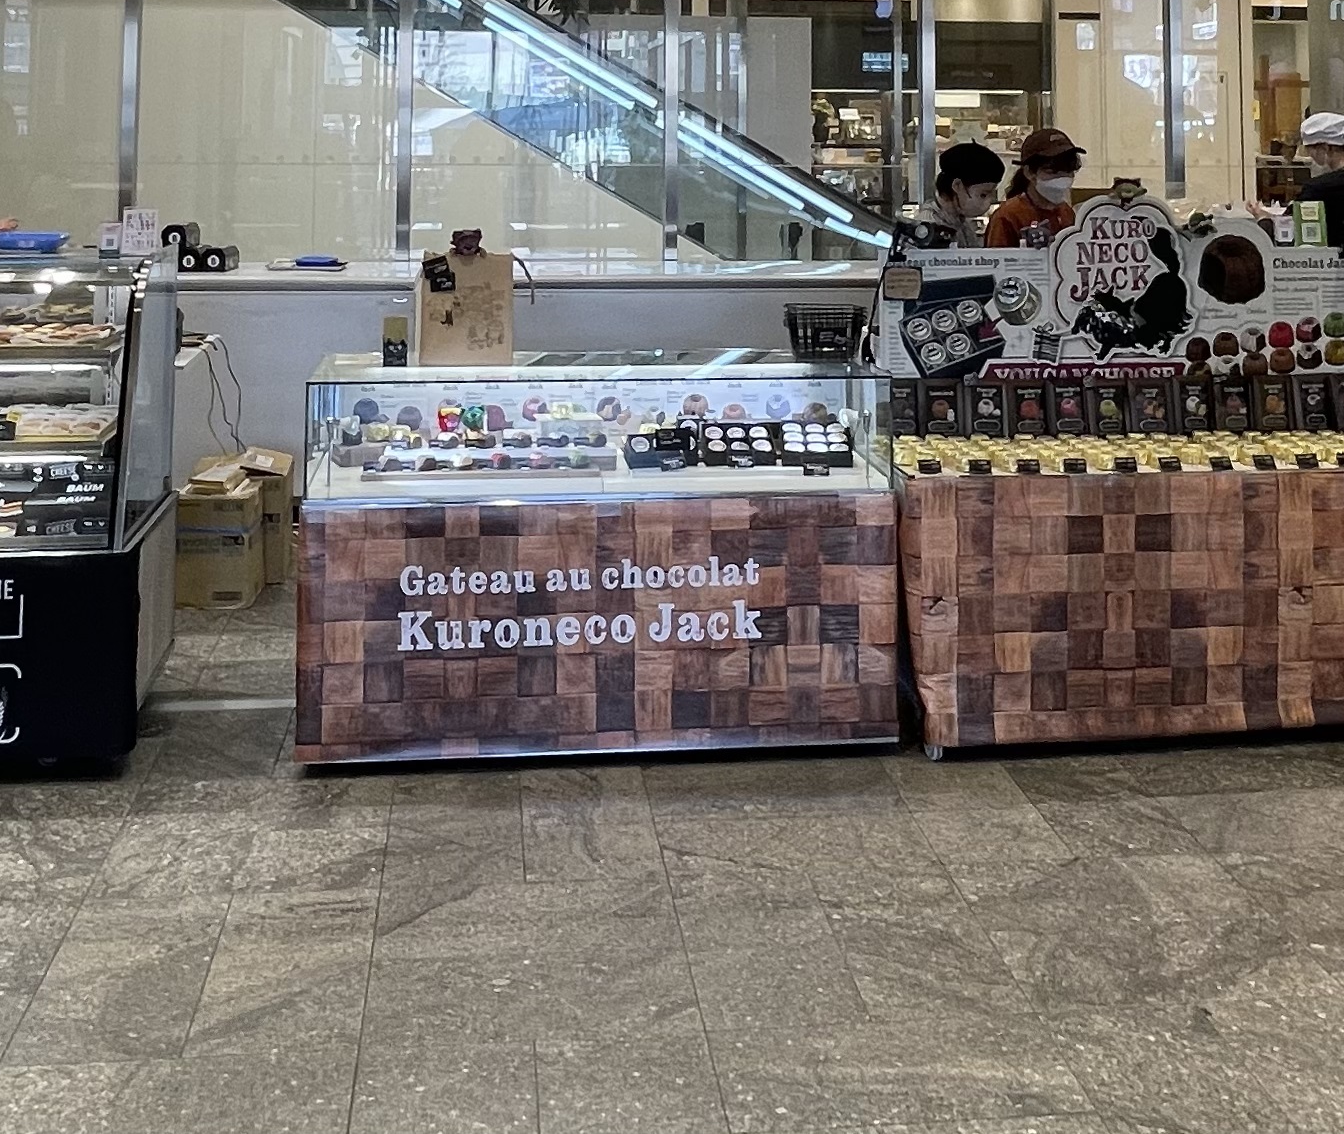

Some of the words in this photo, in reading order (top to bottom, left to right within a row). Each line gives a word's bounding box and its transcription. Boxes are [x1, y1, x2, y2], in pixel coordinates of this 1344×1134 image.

[1088, 216, 1157, 240] KURO
[928, 255, 974, 268] chocolat
[974, 255, 1000, 269] shop
[1076, 239, 1149, 266] NECO
[1272, 257, 1324, 270] Chocolat
[1069, 265, 1152, 303] JACK
[65, 483, 105, 493] BAUM
[399, 563, 537, 597] Gateau
[545, 566, 592, 592] au
[600, 555, 760, 591] chocolat
[396, 610, 637, 652] Kuroneco
[648, 598, 763, 644] Jack
